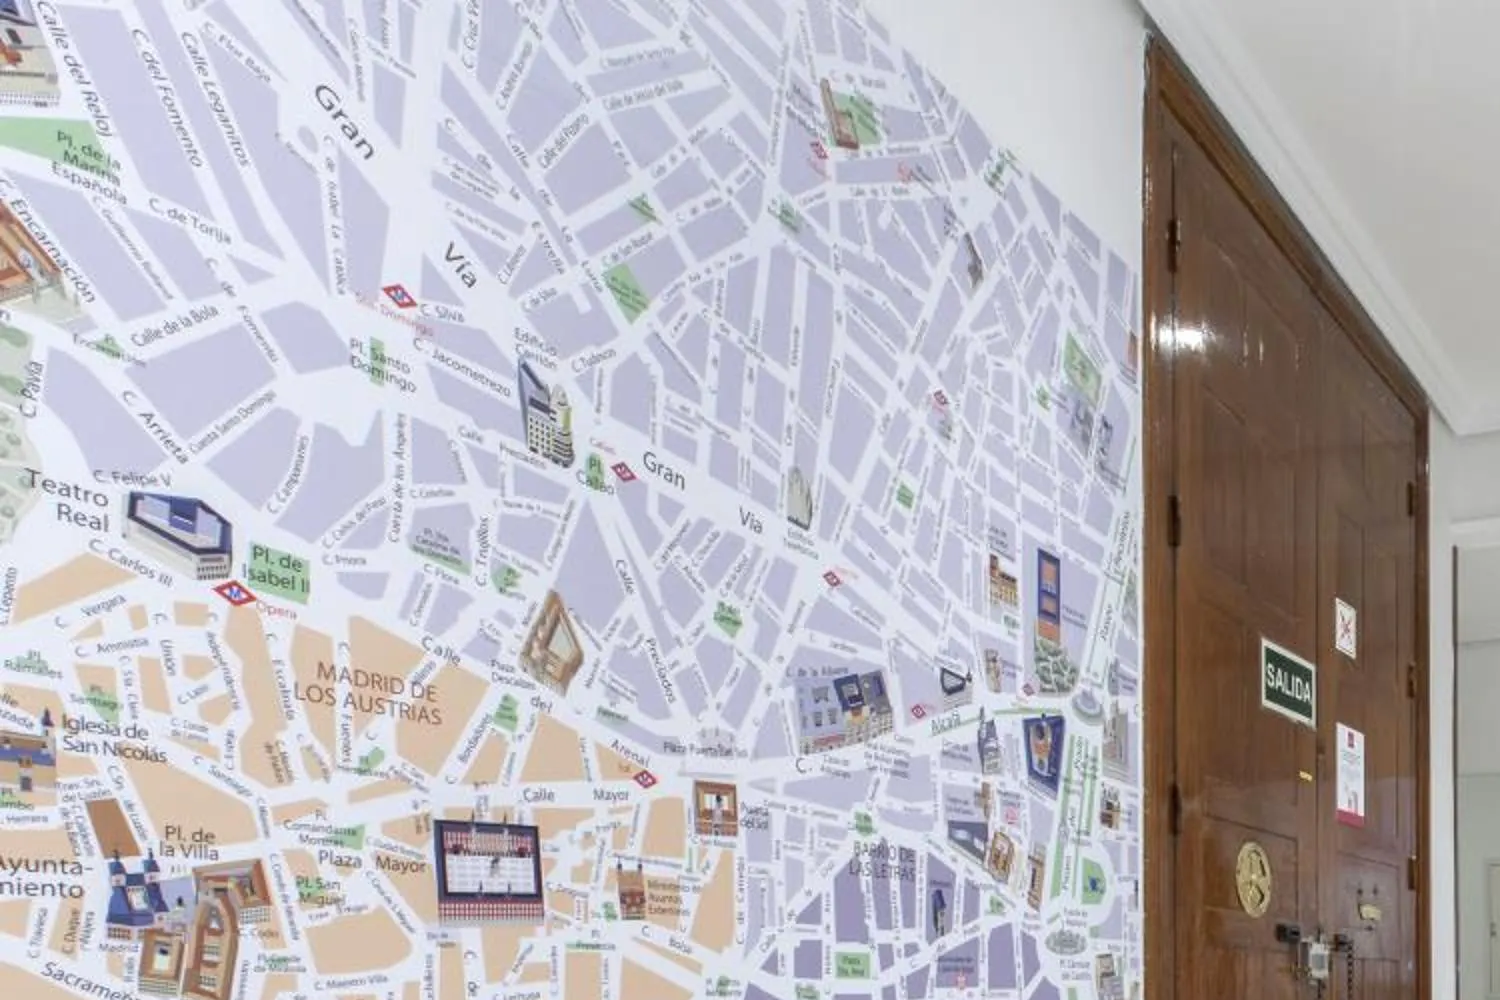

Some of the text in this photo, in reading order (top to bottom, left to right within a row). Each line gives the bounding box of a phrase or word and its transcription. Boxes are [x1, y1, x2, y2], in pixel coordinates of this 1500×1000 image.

[36, 1, 112, 138] Calle del Reloj
[142, 50, 203, 168] del Fomento
[181, 31, 250, 167] Calle Leganitos
[314, 84, 375, 160] Gran
[62, 150, 122, 186] Marina
[167, 208, 233, 246] de Torija
[10, 198, 96, 302] Encarnación
[131, 326, 162, 348] Calle
[140, 412, 190, 465] Arrieta
[25, 468, 109, 508] Teatro
[643, 451, 686, 490] Gran
[56, 503, 109, 533] Real
[107, 549, 155, 582] Carlos
[252, 547, 304, 572] Pl. de
[615, 559, 636, 595] Calle
[317, 660, 439, 702] MADRID DE
[645, 637, 676, 704] Preciados
[1267, 663, 1311, 702] SALIDA
[295, 681, 442, 725] LOS AUSTRIAS
[422, 637, 461, 665] Calle
[610, 740, 650, 767] Arenal
[62, 713, 149, 740] Iglesia de
[63, 736, 168, 763] San Nicolás
[523, 788, 631, 804] Calle Mayor
[159, 841, 219, 861] la Villa
[165, 826, 216, 844] Pl. de
[318, 852, 427, 875] Plaza Mayor
